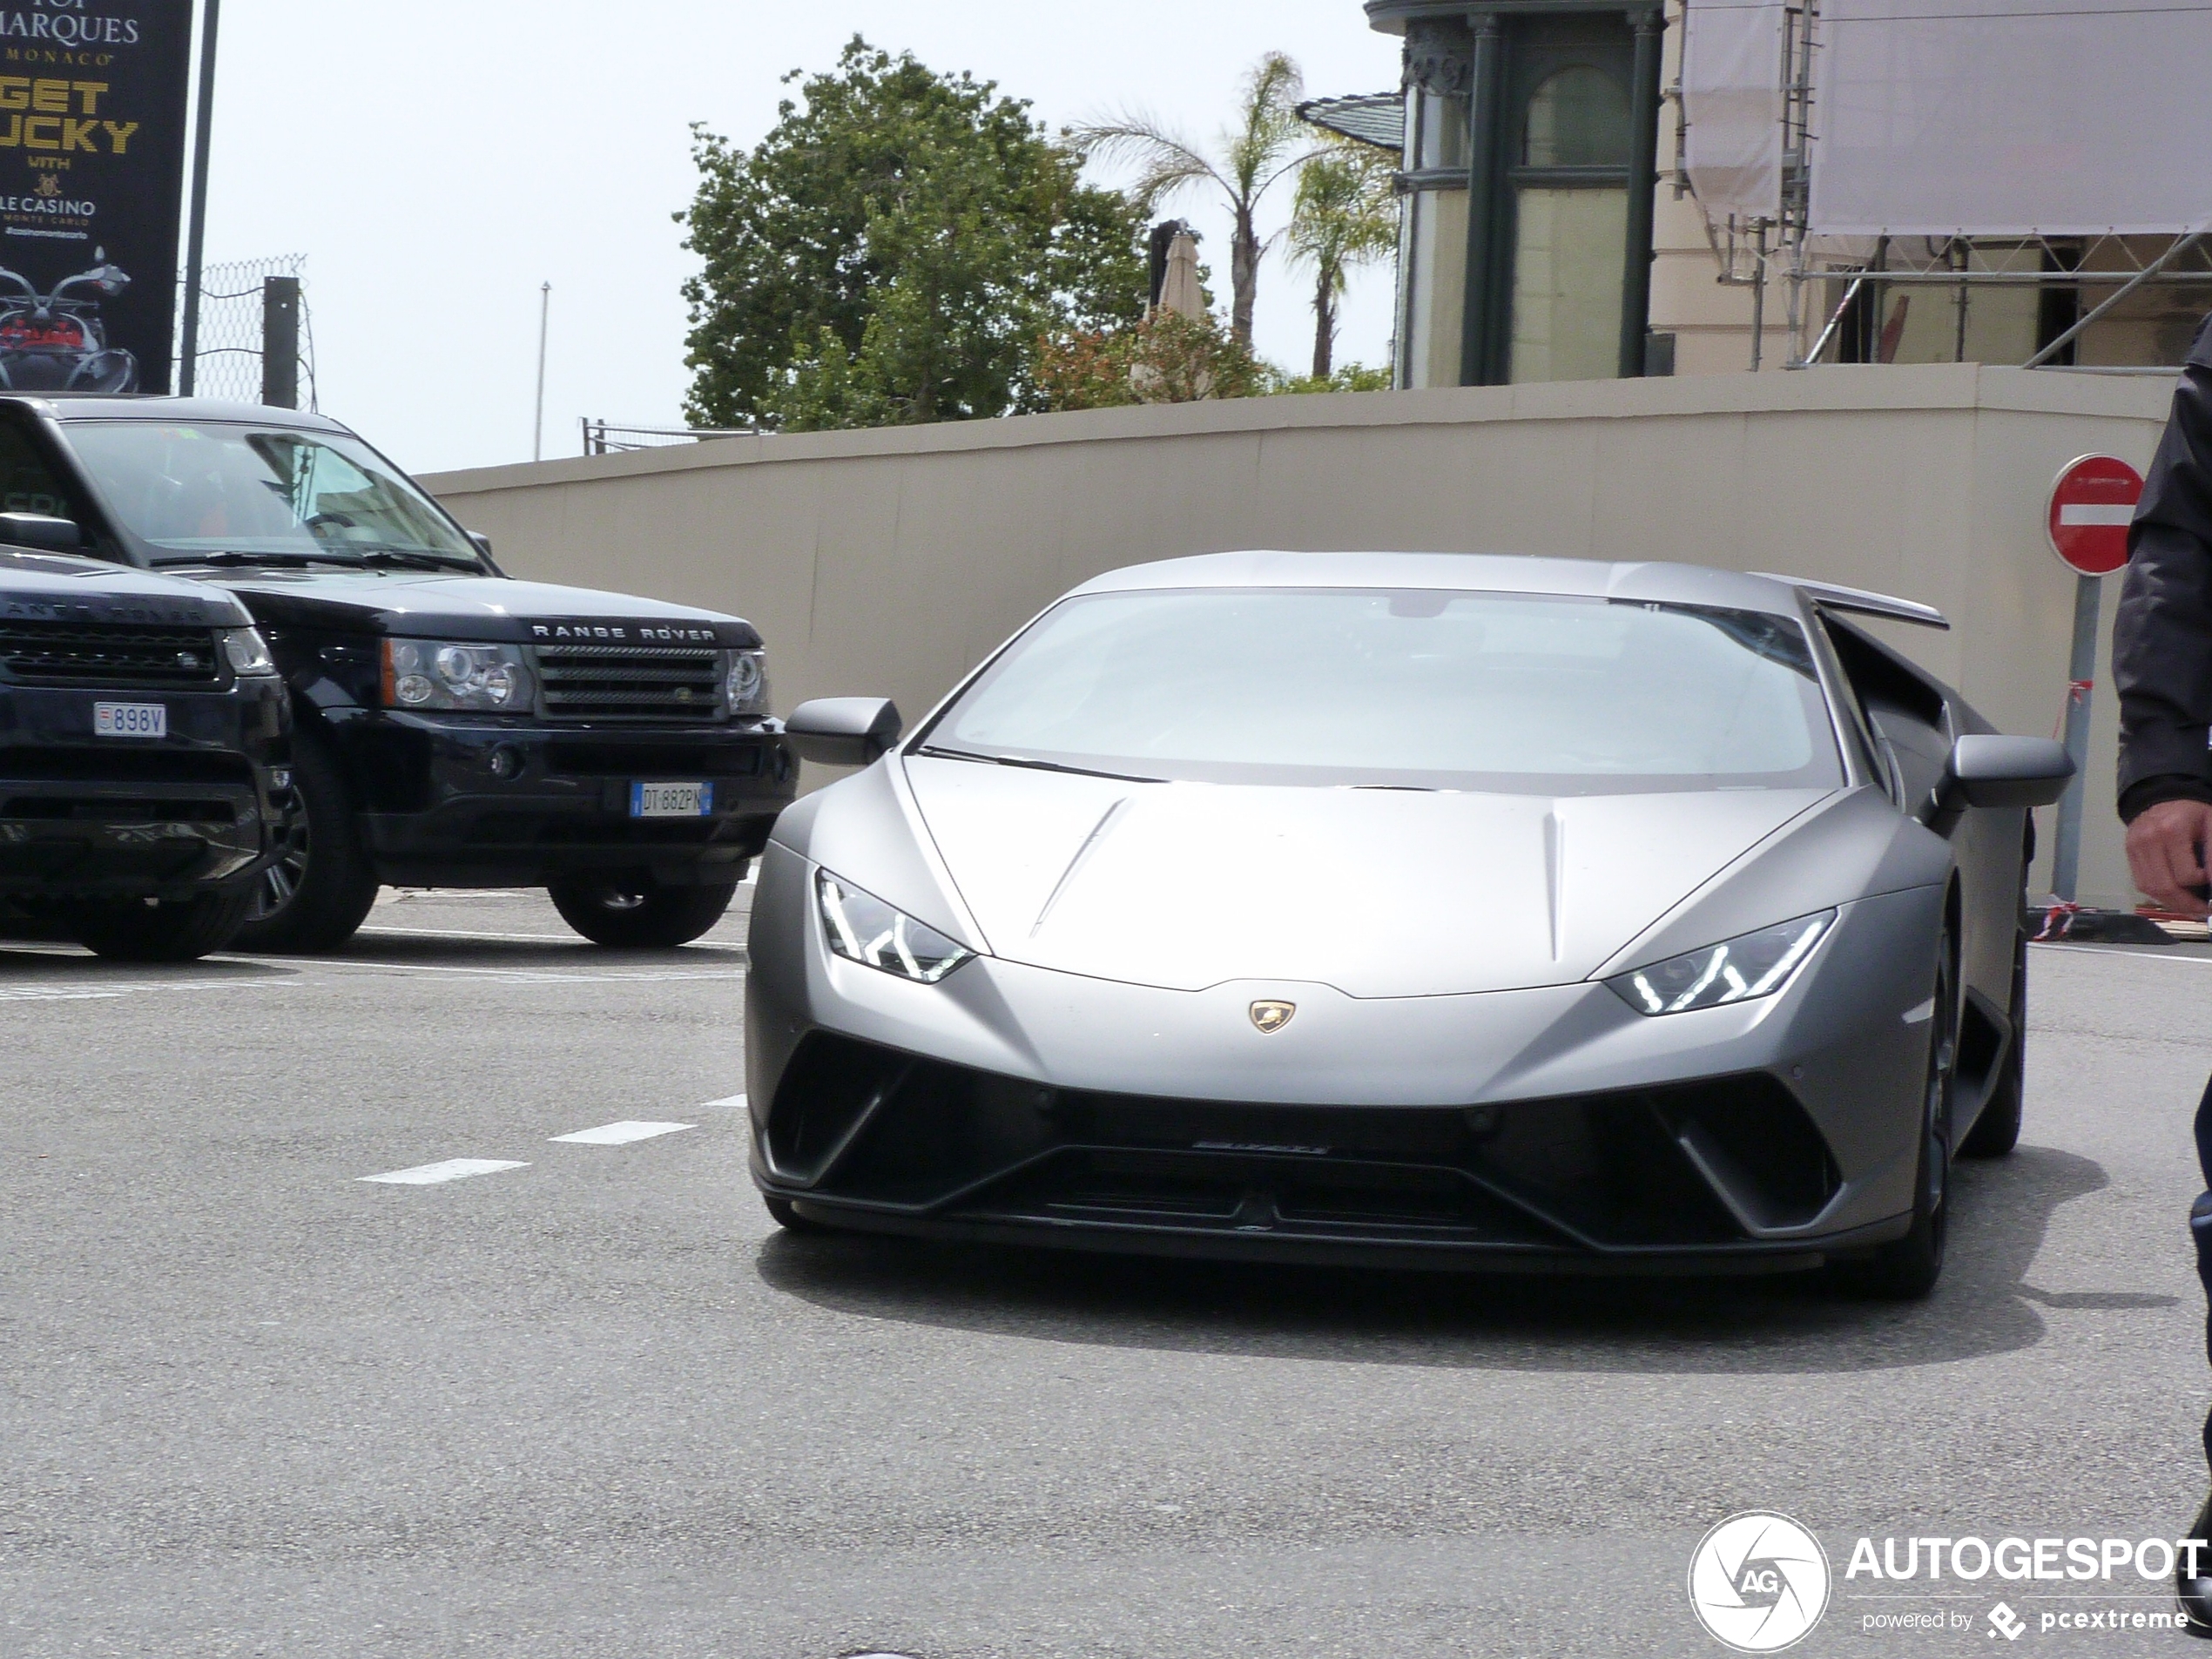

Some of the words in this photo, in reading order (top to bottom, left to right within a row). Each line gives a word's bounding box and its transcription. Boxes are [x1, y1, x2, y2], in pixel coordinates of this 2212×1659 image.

[5, 47, 110, 66] MONACO
[0, 76, 109, 114] GET
[27, 156, 71, 170] WITH
[0, 196, 17, 211] LE
[21, 198, 96, 216] CASINO
[532, 625, 626, 638] RANGE
[640, 628, 716, 641] ROVER
[114, 708, 163, 732] 898V
